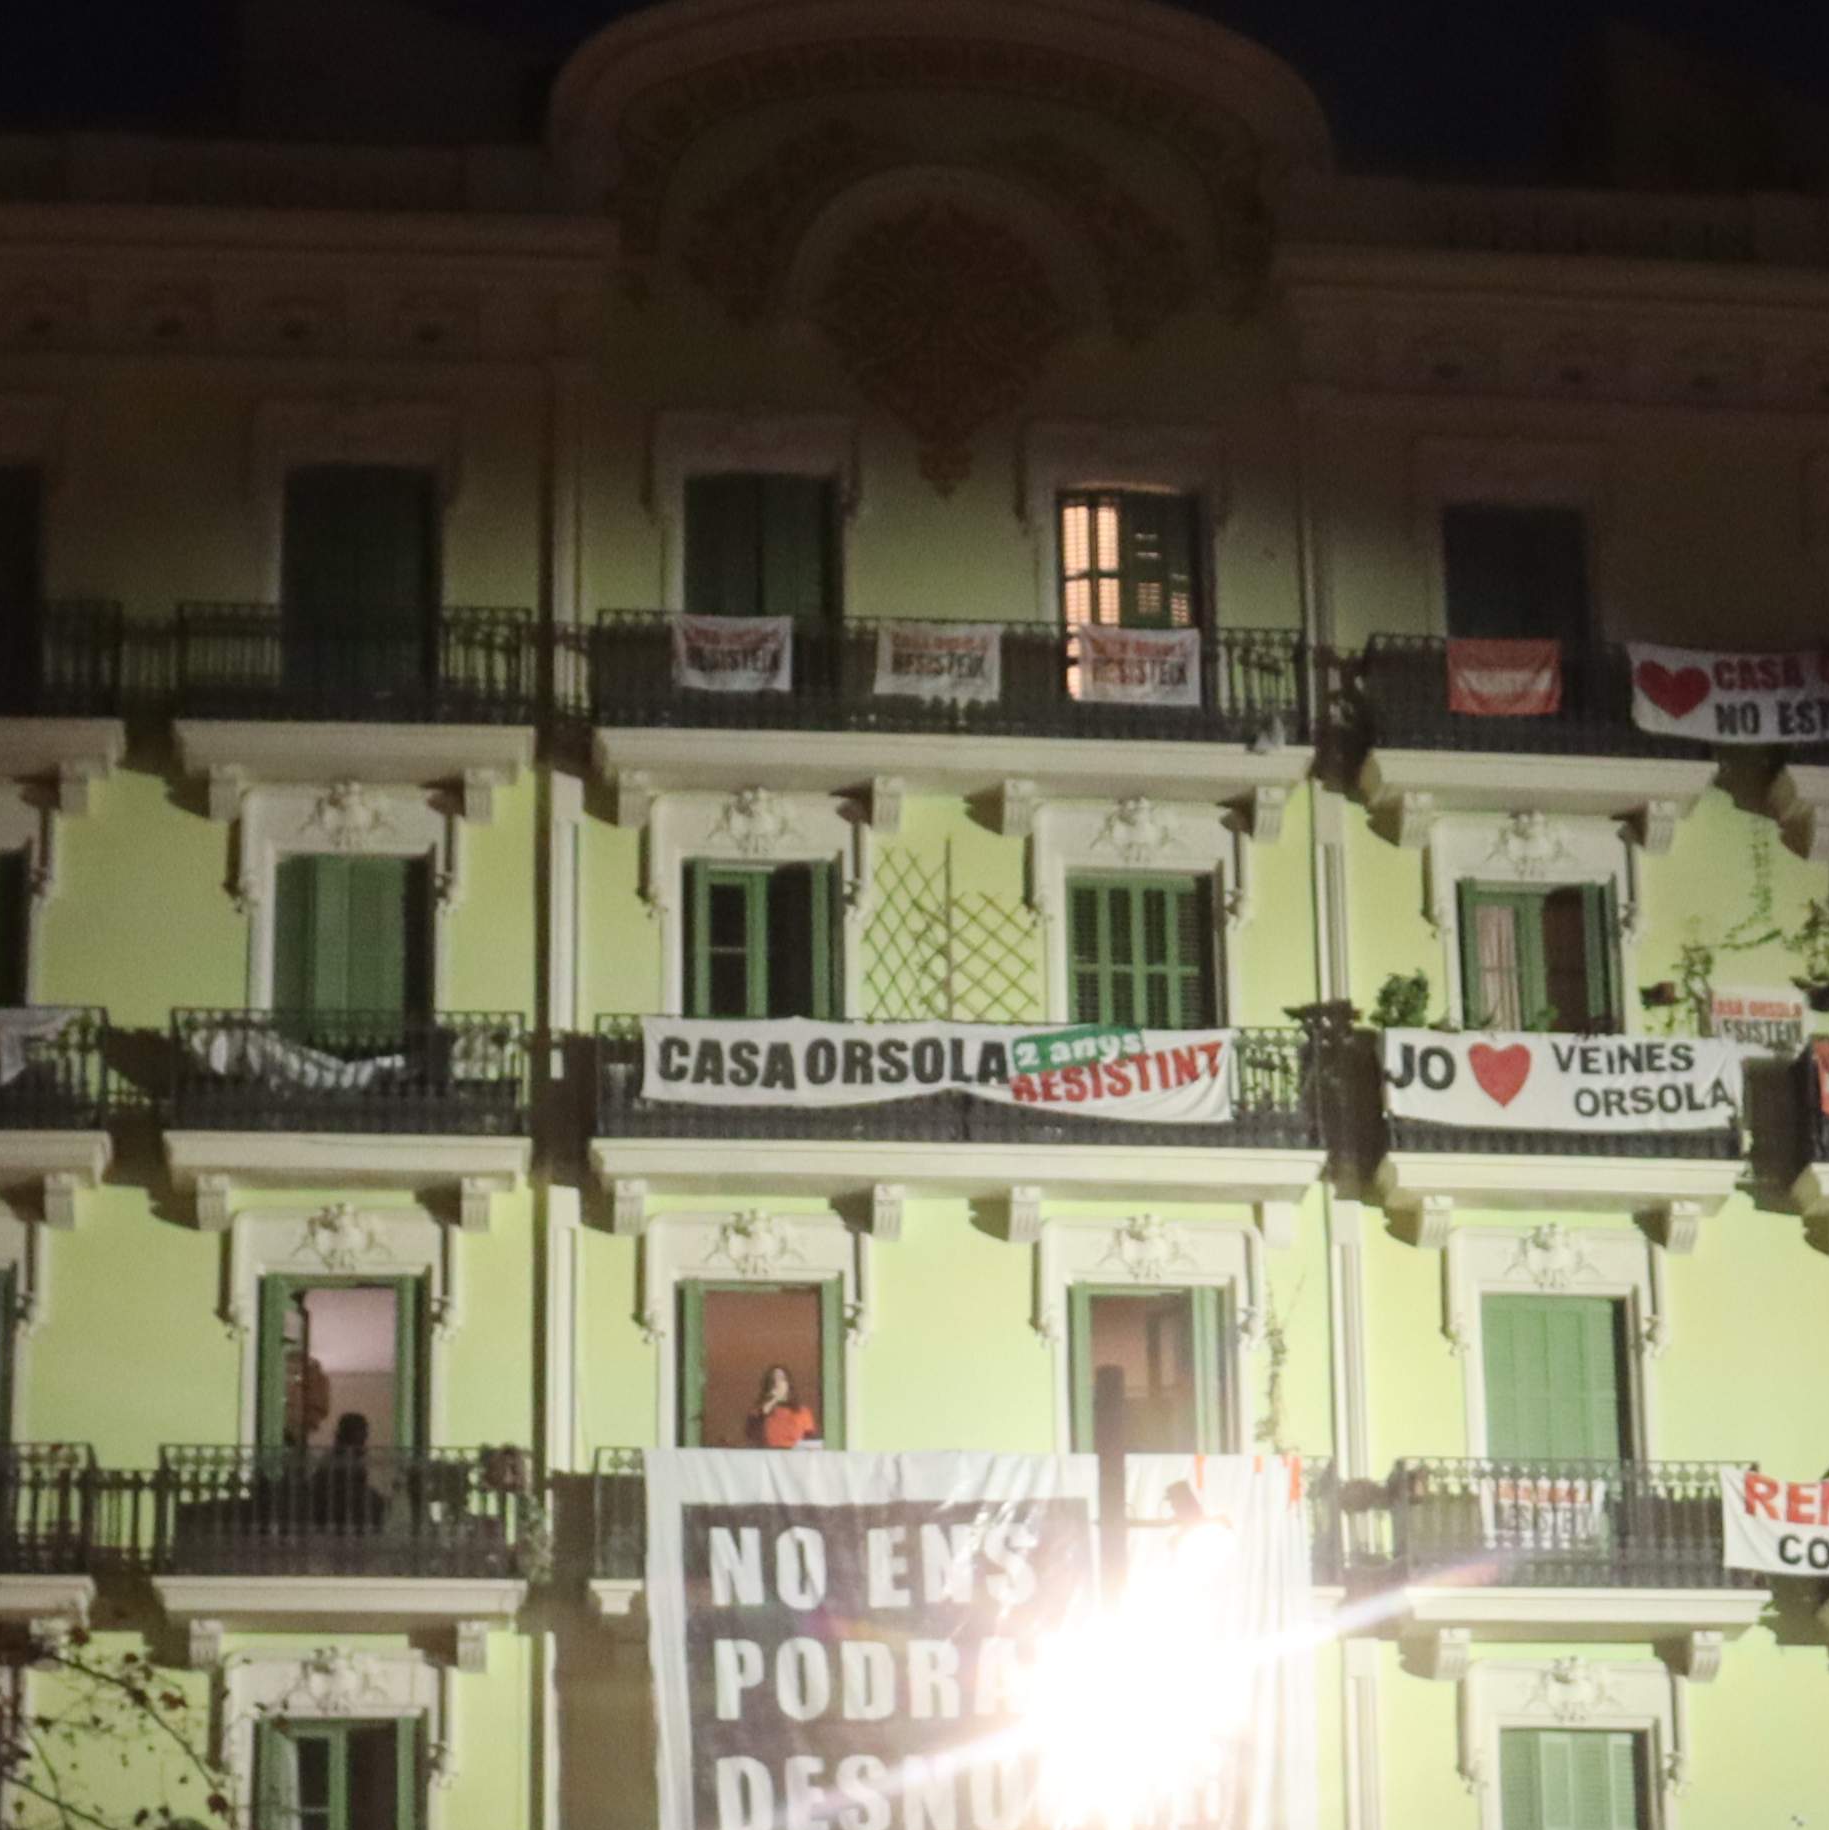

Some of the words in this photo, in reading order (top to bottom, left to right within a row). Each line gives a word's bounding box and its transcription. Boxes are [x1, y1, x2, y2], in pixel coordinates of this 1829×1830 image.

[1713, 657, 1805, 691] CASA
[1714, 701, 1761, 736] NO
[657, 1036, 798, 1091] CASA
[804, 1036, 1011, 1085] ORSOLA
[1010, 1039, 1225, 1104] RESISTINT
[1013, 1040, 1040, 1069] 2
[1050, 1029, 1144, 1065] anys
[1385, 1042, 1457, 1091] JO
[1551, 1041, 1695, 1075] VEINES
[1573, 1078, 1738, 1118] ORSOLA
[709, 1525, 827, 1610] NO
[868, 1521, 1039, 1609] ENS
[714, 1637, 1040, 1722] PODRA
